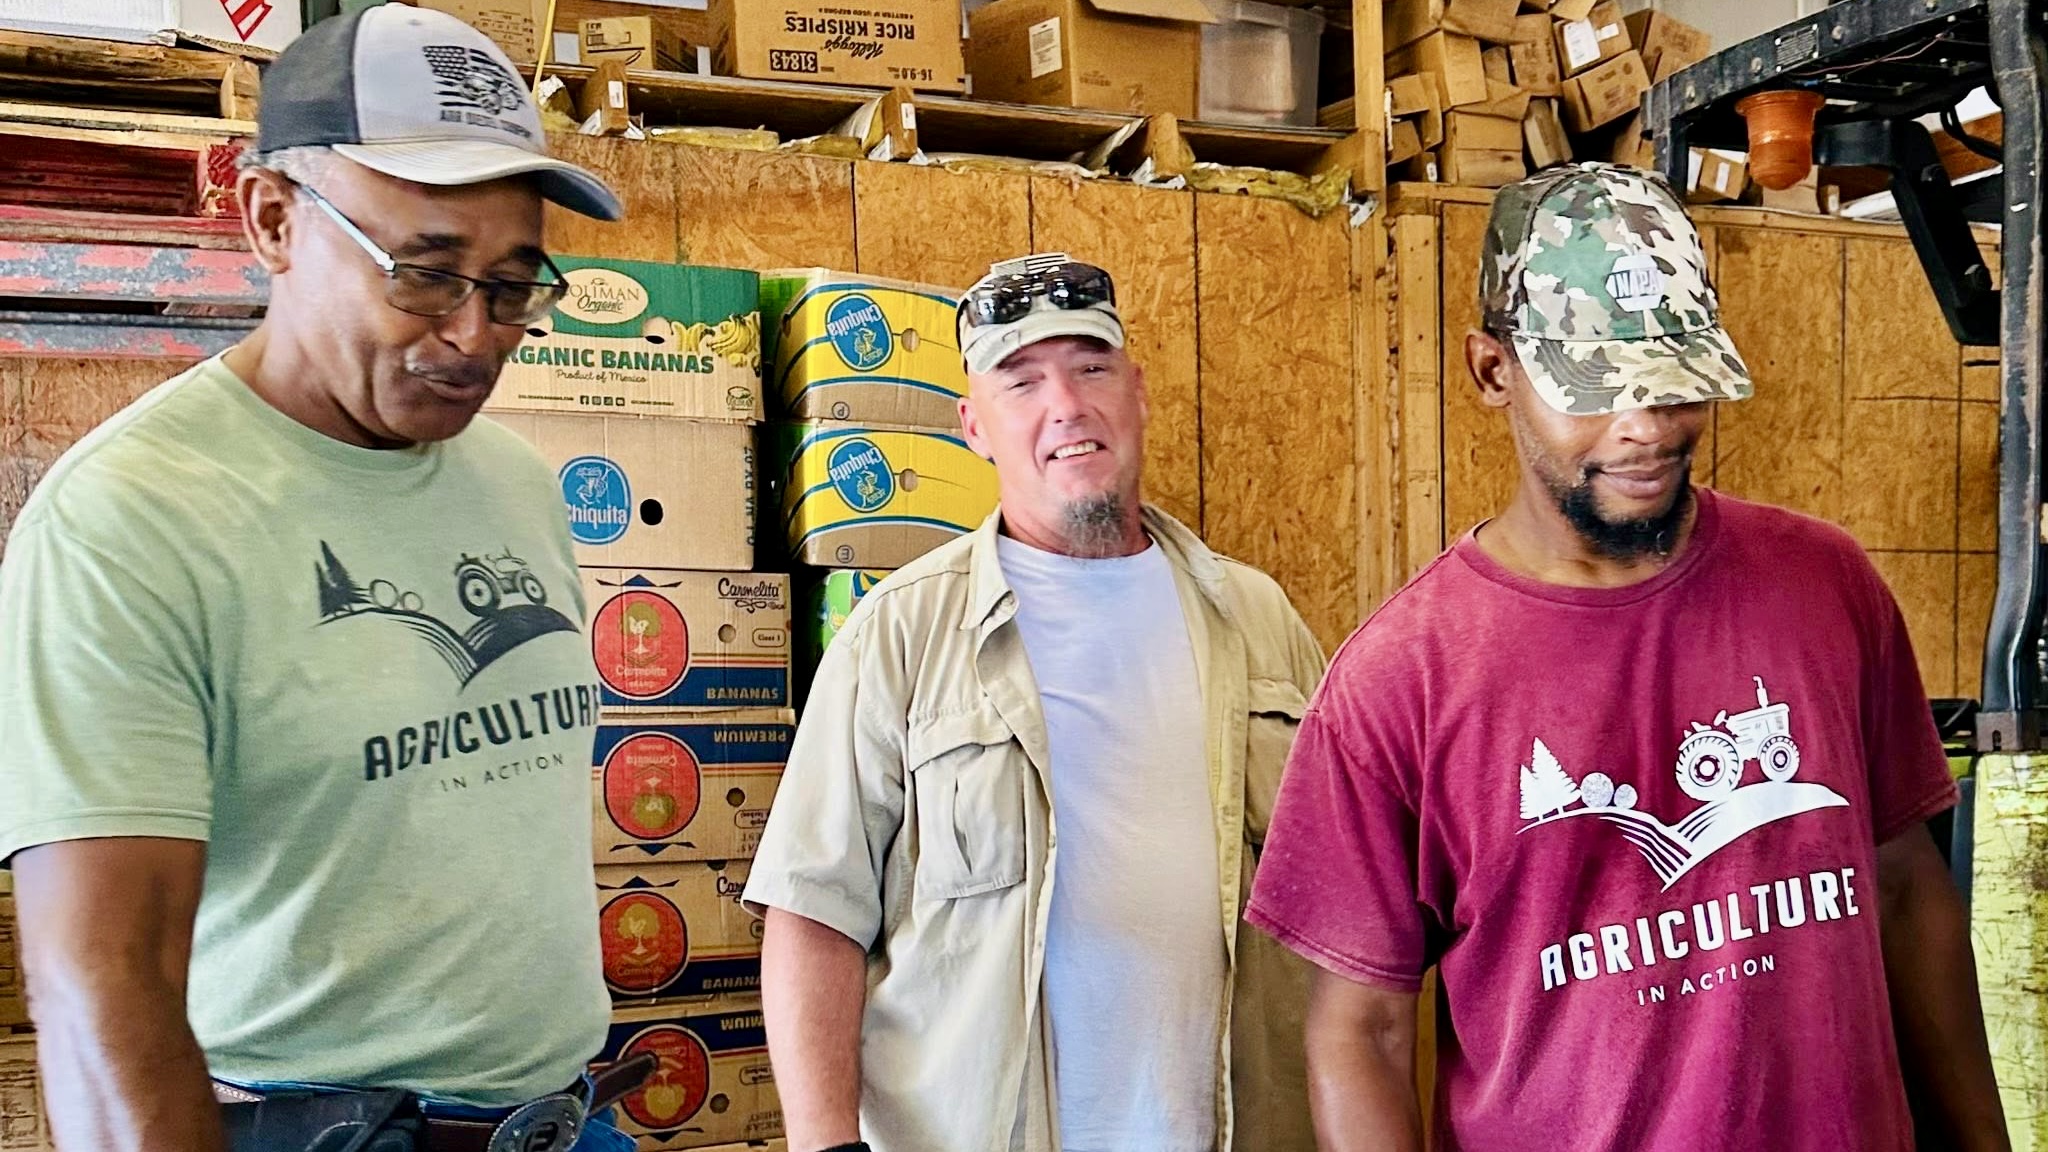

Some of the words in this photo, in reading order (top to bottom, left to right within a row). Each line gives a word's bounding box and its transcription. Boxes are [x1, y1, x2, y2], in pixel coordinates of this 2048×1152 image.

[785, 16, 868, 37] KRISPIES
[875, 22, 915, 40] RICE
[825, 35, 884, 60] Kellogg's
[771, 51, 817, 72] 31843
[567, 284, 640, 301] OLIMAN
[1614, 268, 1660, 298] NAPA
[577, 294, 624, 314] Organic
[827, 303, 884, 337] Chiquita
[505, 345, 595, 368] RGANIC
[601, 350, 714, 374] BANANAS
[555, 368, 594, 381] Product
[596, 371, 607, 382] of
[609, 371, 647, 383] Mexico
[829, 446, 884, 482] Chiquita
[718, 577, 779, 598] Carmelita
[616, 663, 668, 677] Carmelita
[706, 687, 779, 700] BANANAS
[713, 730, 787, 743] PREMIUM
[440, 775, 467, 792] IN
[483, 752, 564, 784] ACTION
[1540, 867, 1859, 991] AGRICULTURE
[1637, 985, 1666, 1006] IN
[1680, 954, 1776, 995] ACTION
[720, 1014, 764, 1031] MIUM
